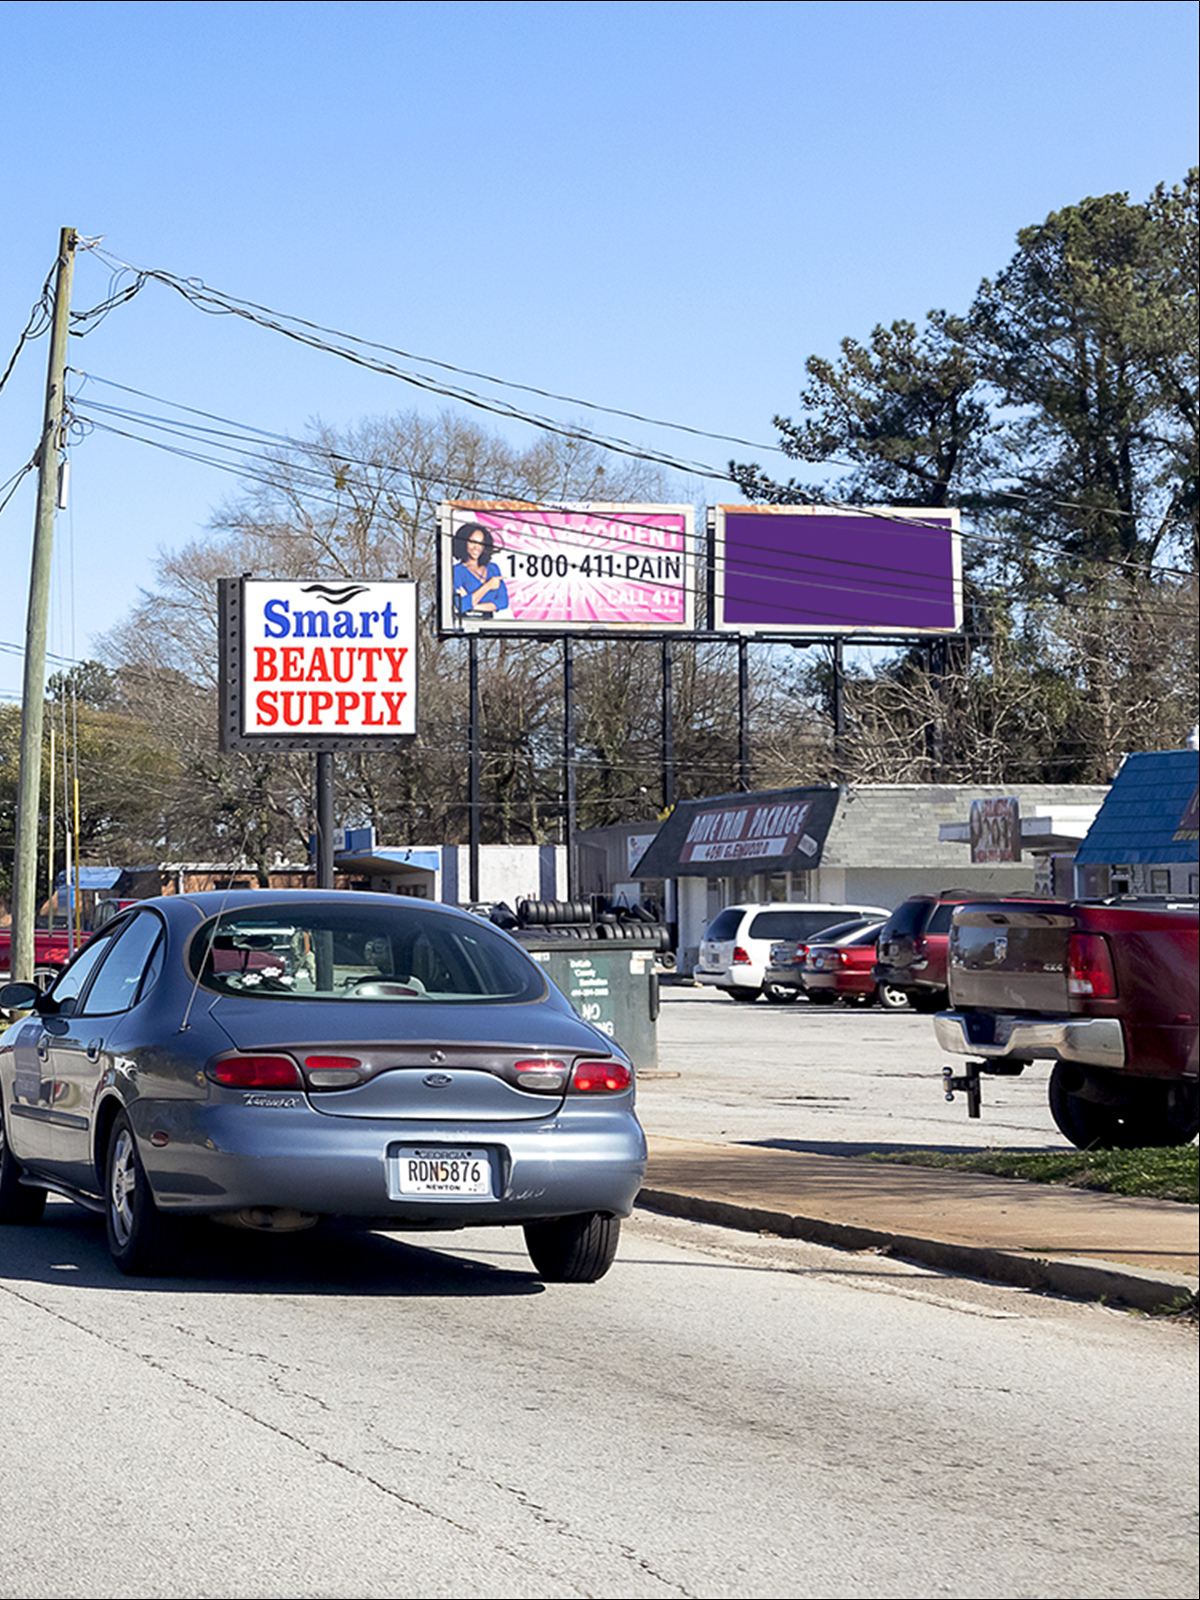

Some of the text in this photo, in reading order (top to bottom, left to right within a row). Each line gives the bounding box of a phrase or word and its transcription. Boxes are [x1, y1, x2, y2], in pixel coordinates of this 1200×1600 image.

[503, 523, 681, 547] CAR ACCIDENT
[513, 588, 566, 605] AFTER
[607, 590, 648, 605] CALL
[652, 590, 680, 606] 411
[263, 599, 399, 639] Smart
[253, 646, 409, 684] BEAUTY
[256, 690, 408, 727] SUPPLY
[685, 812, 723, 843] DRIVE
[747, 803, 810, 838] PACKAGE
[582, 1003, 601, 1020] NO
[419, 1150, 467, 1160] GEORGIA
[408, 1160, 481, 1182] RDN5876
